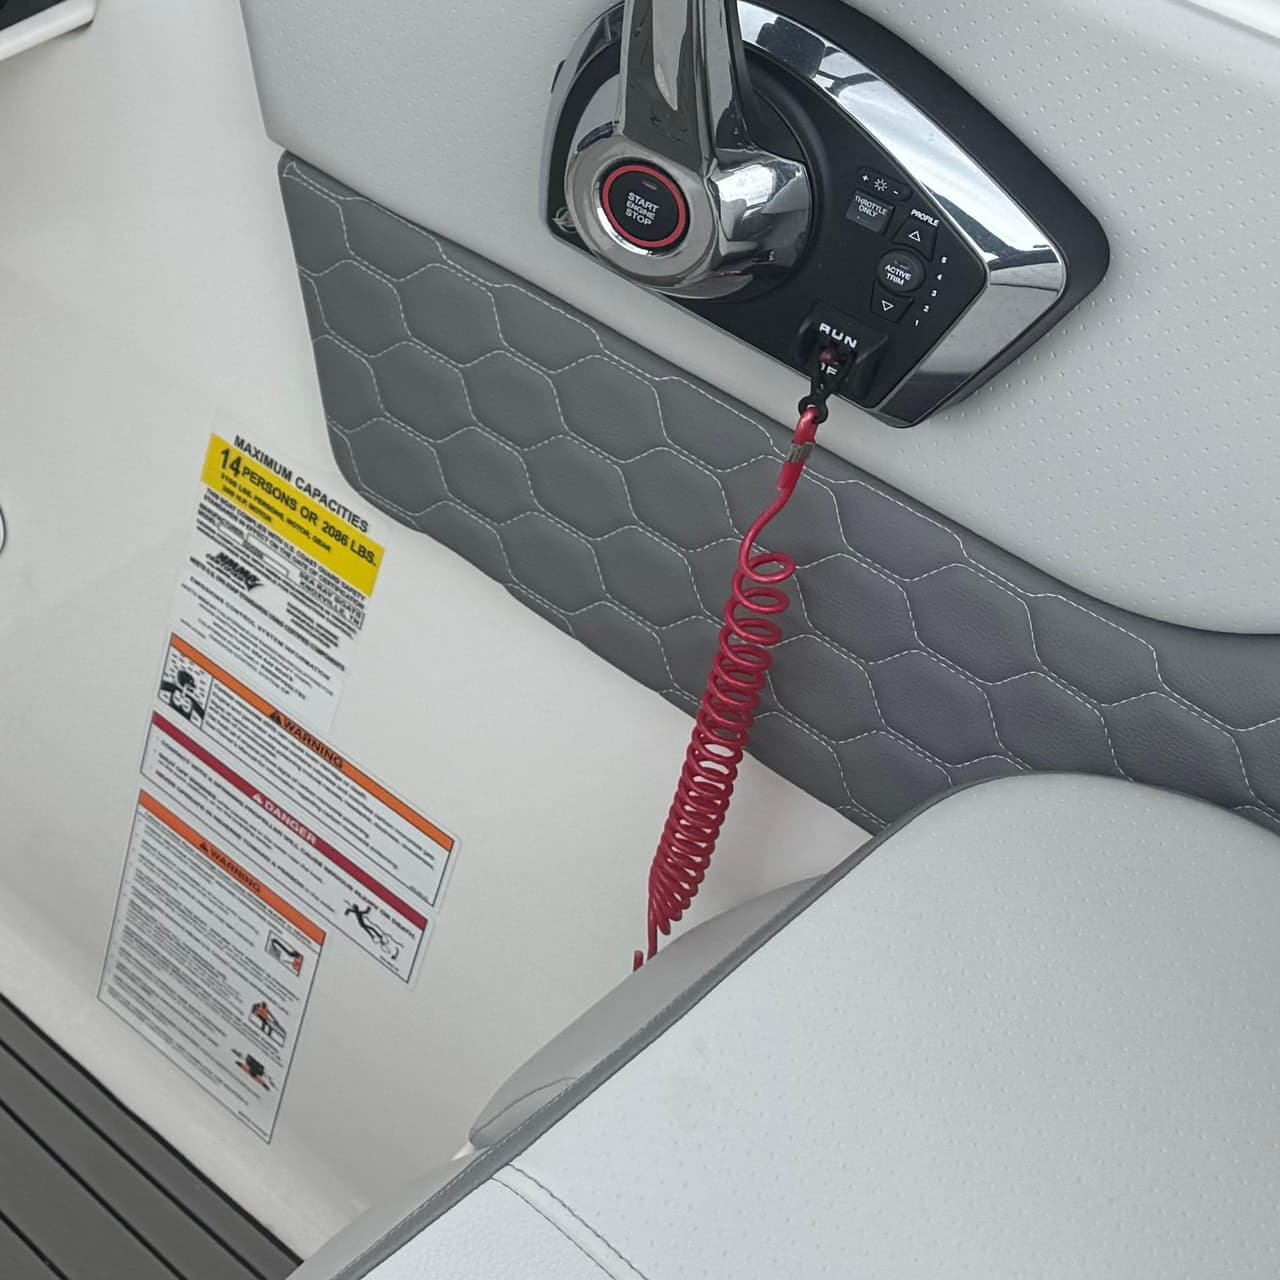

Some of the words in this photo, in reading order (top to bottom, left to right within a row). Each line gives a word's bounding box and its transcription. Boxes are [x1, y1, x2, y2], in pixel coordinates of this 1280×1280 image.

[625, 200, 656, 221] ENGINE
[627, 192, 660, 213] START
[854, 194, 888, 216] THROTTLE
[858, 204, 879, 218] ONLY
[625, 208, 653, 226] STOP
[910, 208, 940, 228] PROFILE
[884, 263, 912, 282] ACTIVE
[886, 272, 905, 287] TRIM
[819, 322, 858, 349] RUN
[234, 434, 292, 482] MAXIMUM
[294, 475, 368, 533] CAPACITIES
[220, 447, 242, 478] 14
[242, 465, 297, 511] PERSONS
[299, 504, 317, 525] OR
[321, 520, 348, 546] 2086
[350, 539, 377, 566] LBS.
[282, 716, 343, 769] WARNING
[264, 798, 316, 845] DANGER
[209, 846, 260, 894] WARNING
